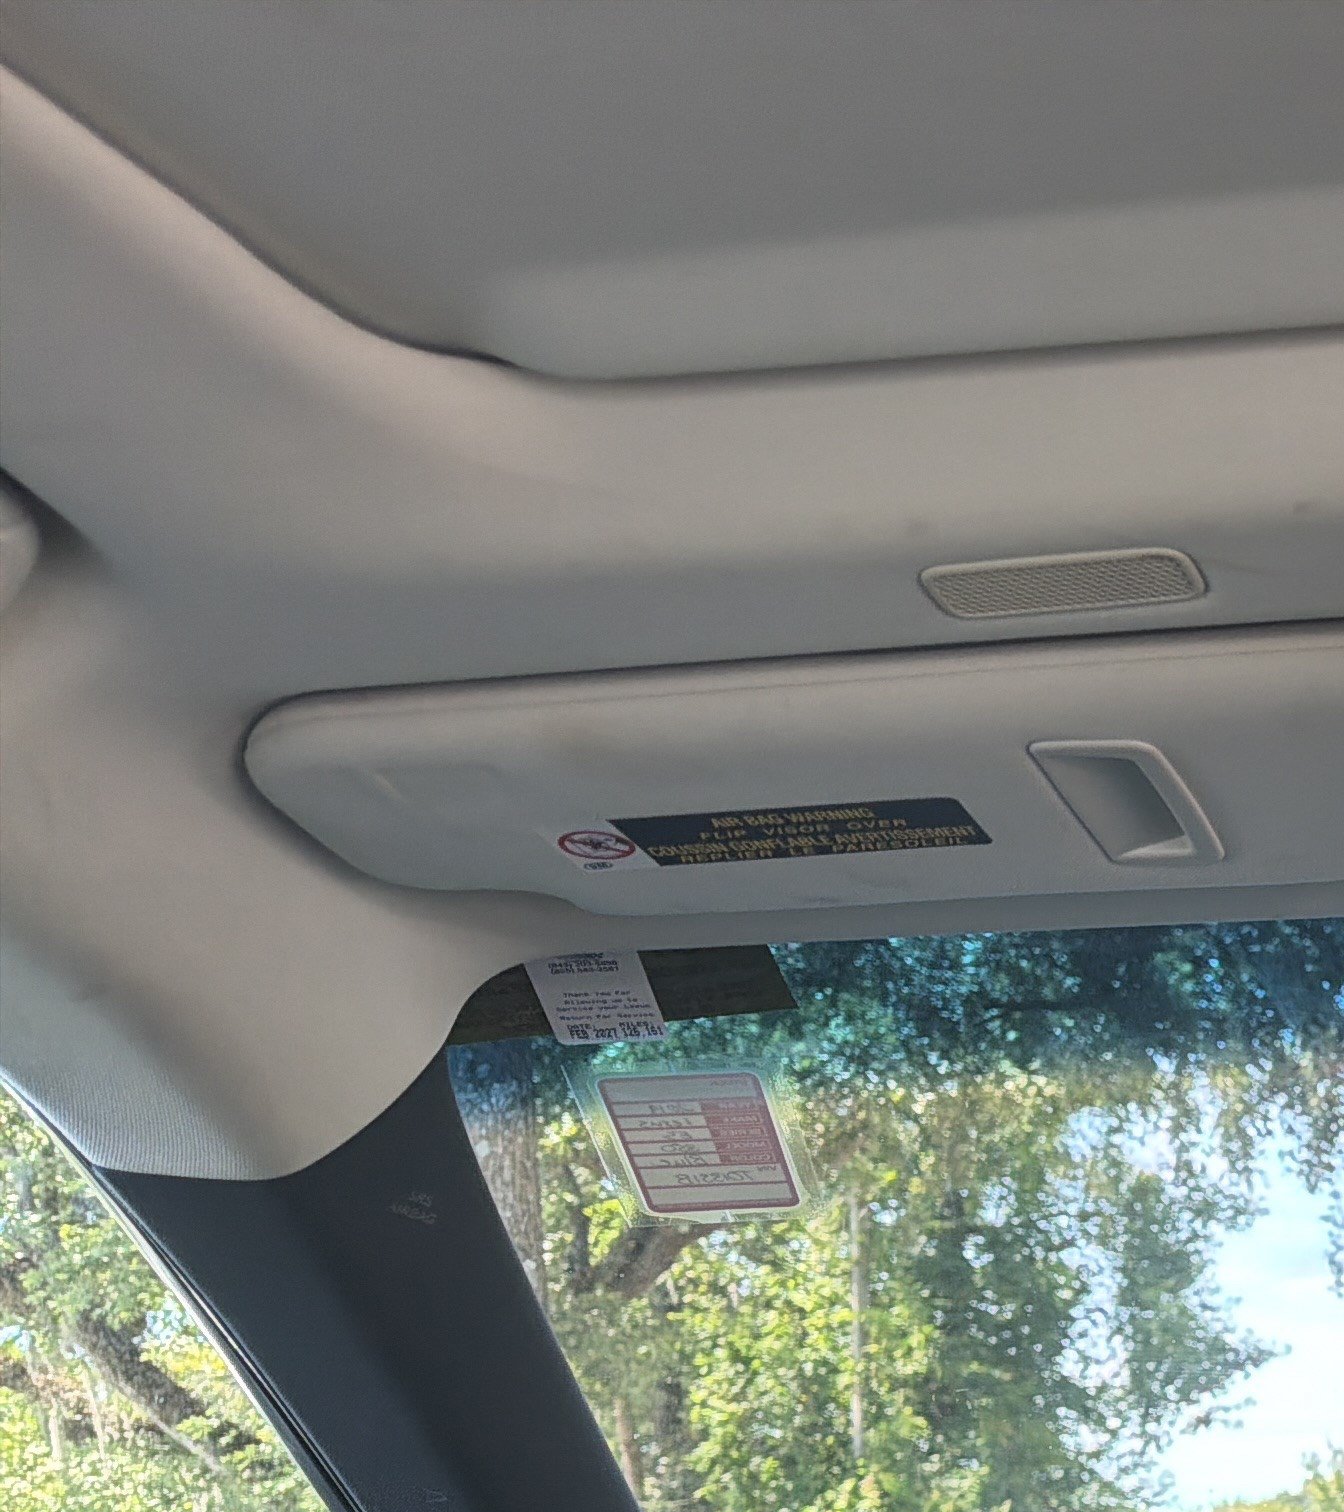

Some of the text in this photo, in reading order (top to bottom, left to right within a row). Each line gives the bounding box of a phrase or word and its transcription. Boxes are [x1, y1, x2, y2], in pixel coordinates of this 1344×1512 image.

[711, 808, 876, 829] AIR BAG WARNING
[847, 818, 907, 831] OVER
[569, 1029, 589, 1040] FEB
